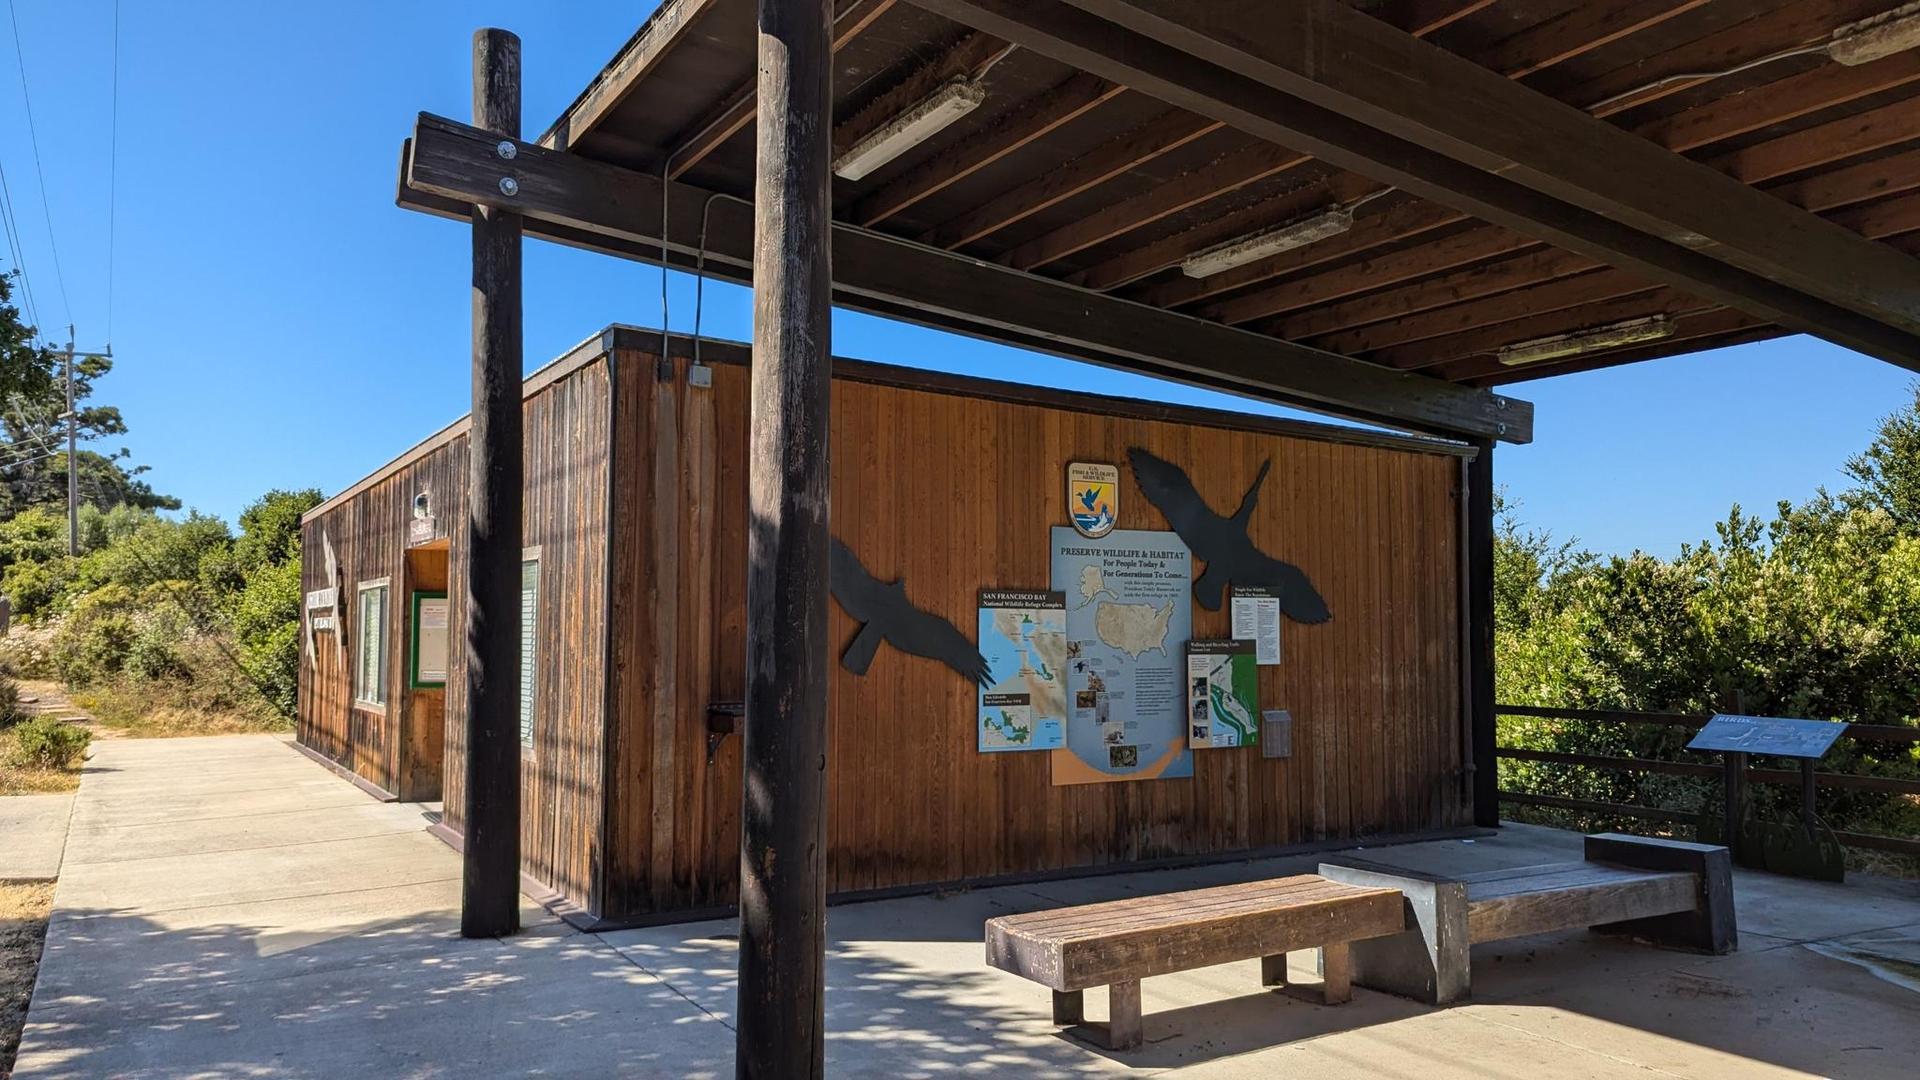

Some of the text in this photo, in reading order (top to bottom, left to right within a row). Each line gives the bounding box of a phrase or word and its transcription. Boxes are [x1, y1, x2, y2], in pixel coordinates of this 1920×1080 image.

[1060, 547, 1185, 560] PRESERVE WILDLIFE & HABITAT
[1103, 559, 1114, 567] For
[1116, 559, 1138, 570] People
[1138, 560, 1159, 570] Today
[1103, 569, 1114, 577] For
[1115, 570, 1153, 578] Generations
[983, 592, 1048, 601] SAN FRANCISCO BAY
[1025, 601, 1041, 609] Refuge
